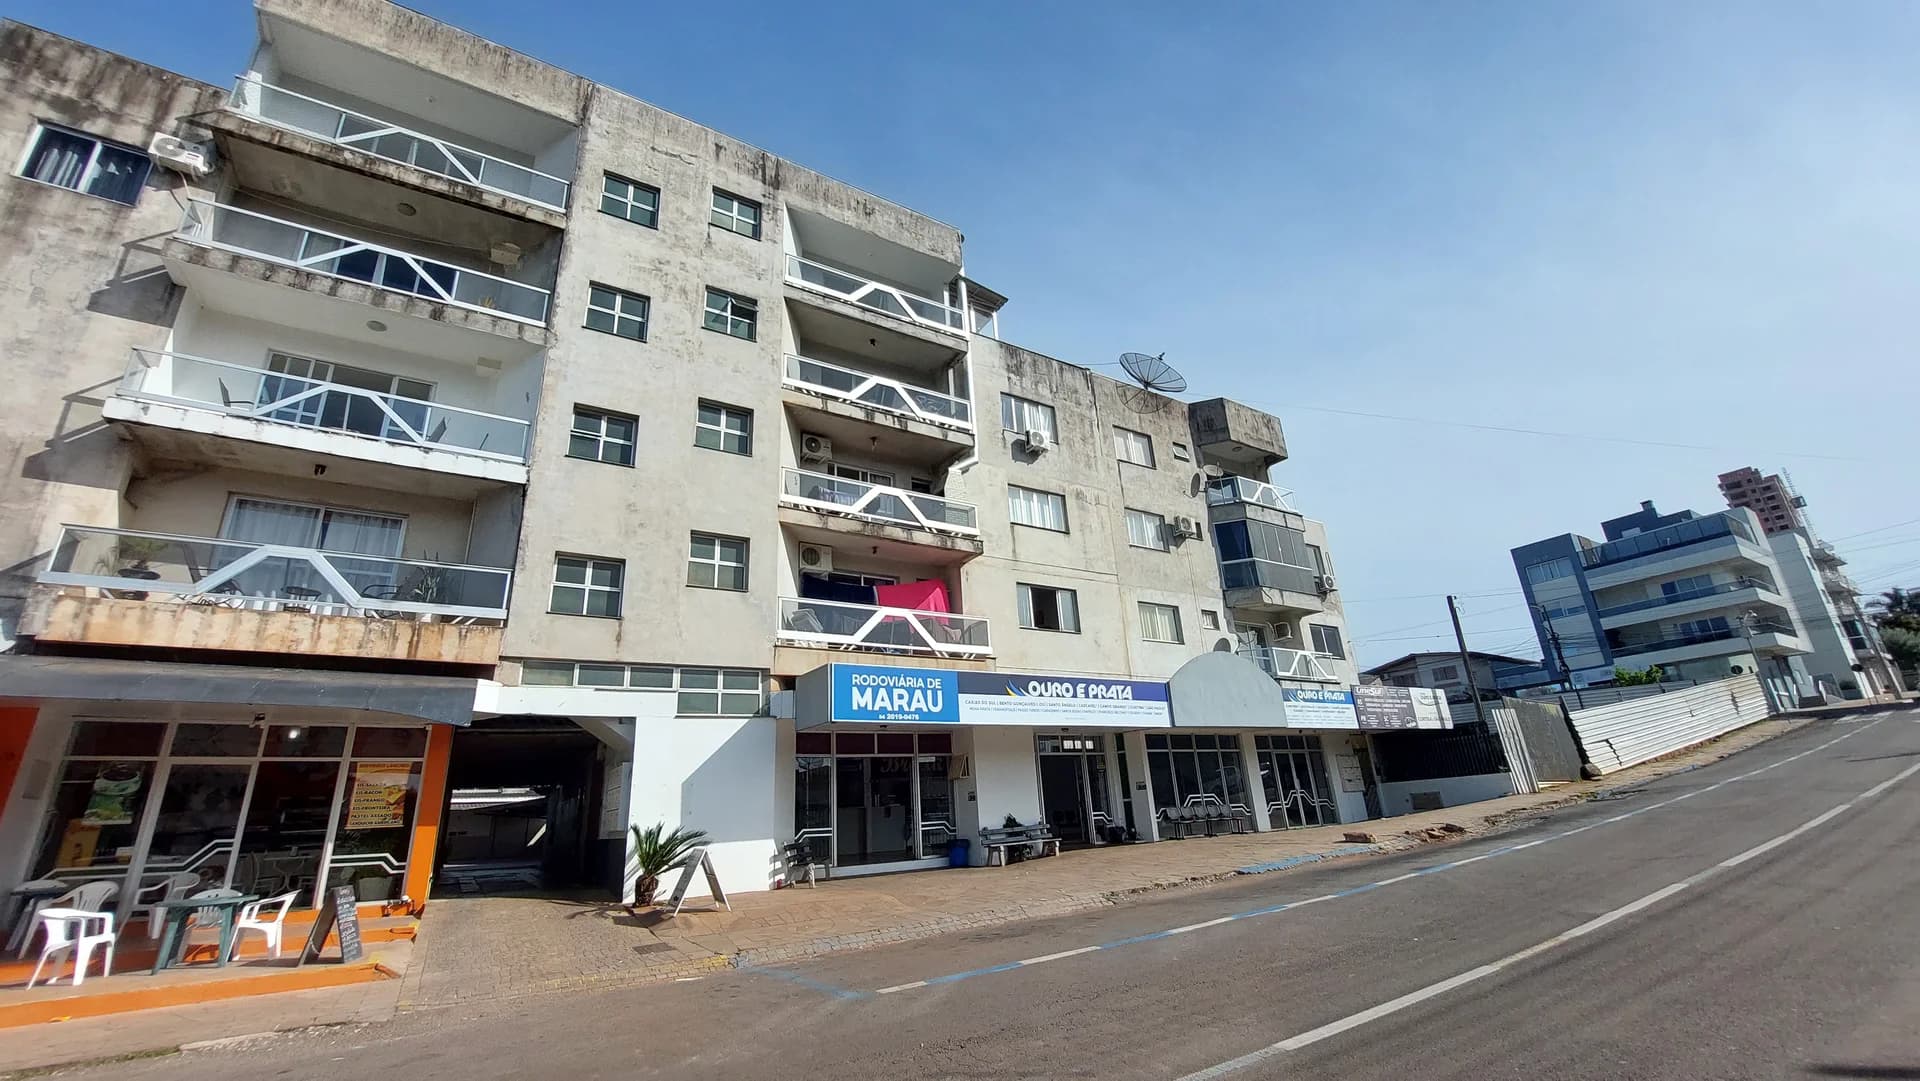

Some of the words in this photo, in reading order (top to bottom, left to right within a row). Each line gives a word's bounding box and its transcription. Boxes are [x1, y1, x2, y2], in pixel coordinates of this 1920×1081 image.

[851, 674, 925, 688] RODOVIÁRIA
[927, 678, 942, 689] DE
[1027, 680, 1074, 698] OURO
[1077, 683, 1086, 697] E
[1088, 684, 1133, 700] PRATA
[851, 687, 943, 712] MARAU
[1297, 690, 1318, 699] OURO
[1318, 692, 1323, 700] E
[1324, 692, 1345, 701] PRATA
